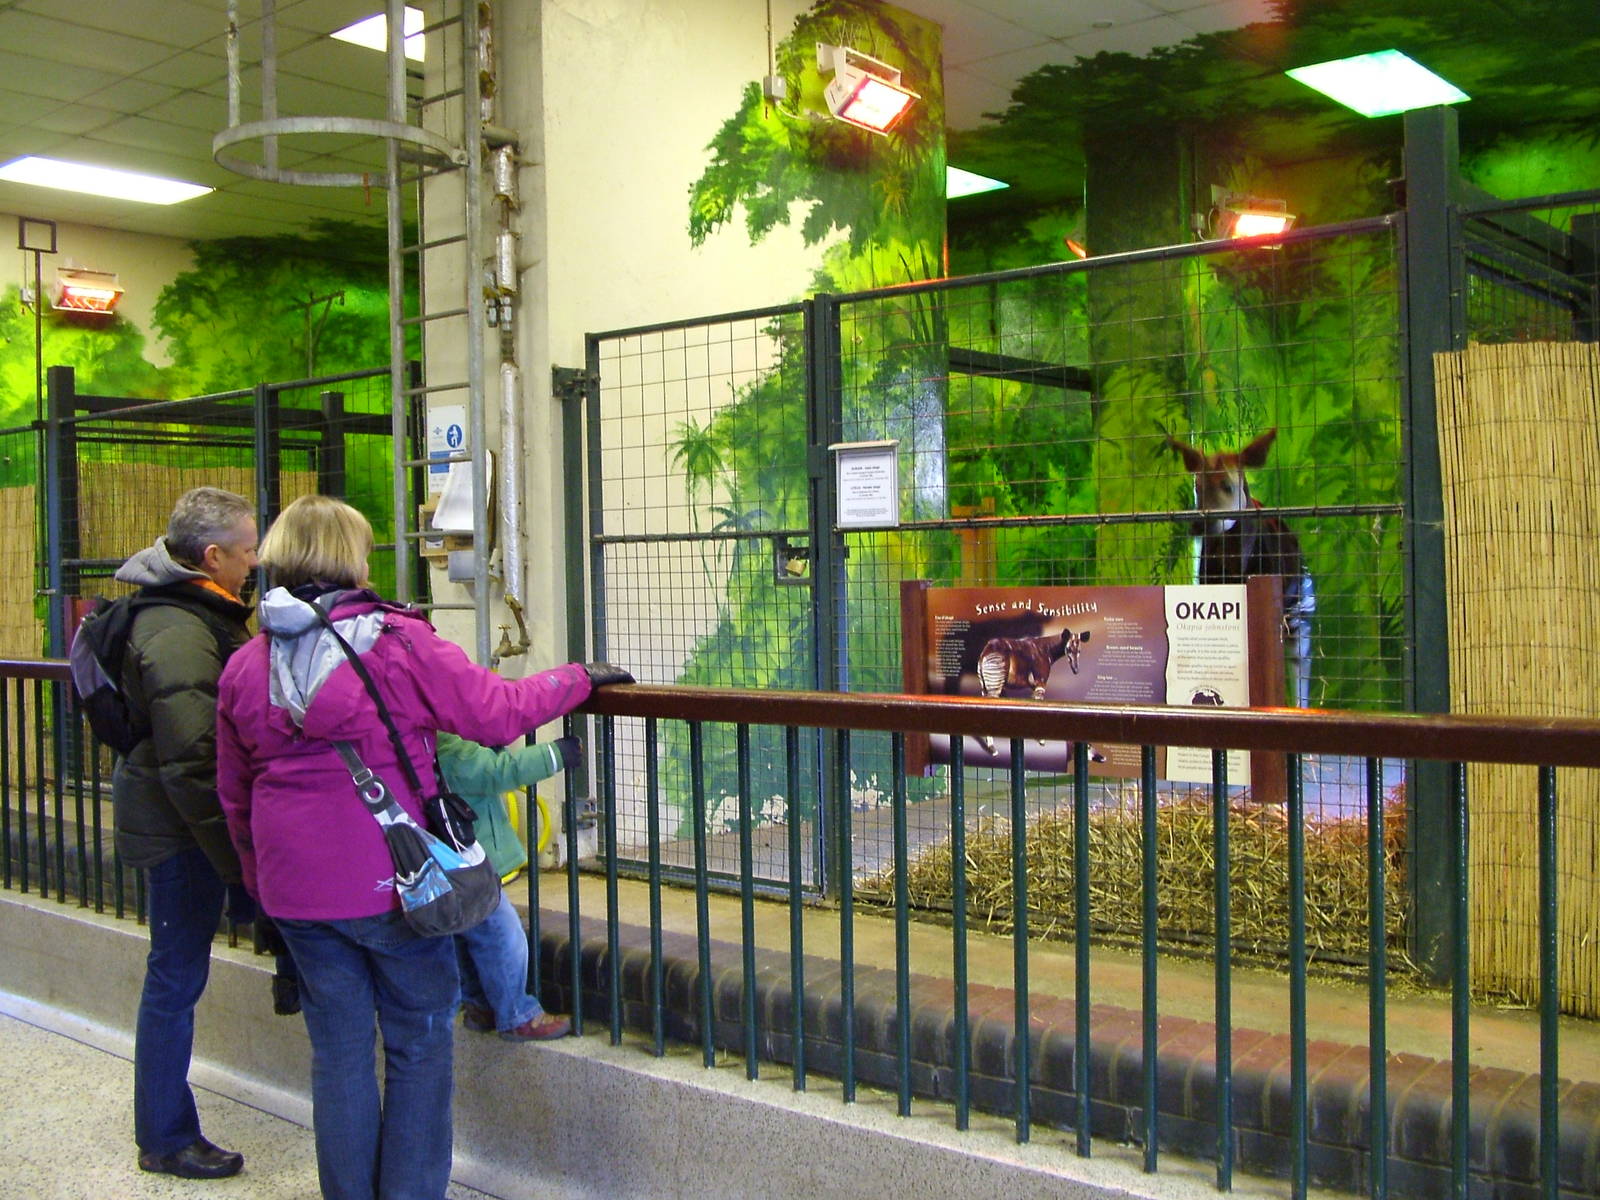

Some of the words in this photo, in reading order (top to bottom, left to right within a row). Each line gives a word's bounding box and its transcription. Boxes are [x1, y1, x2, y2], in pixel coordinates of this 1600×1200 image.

[976, 602, 1006, 615] Sense
[1012, 598, 1031, 610] and
[1037, 602, 1097, 616] Sensibility
[1175, 602, 1240, 620] OKAPI
